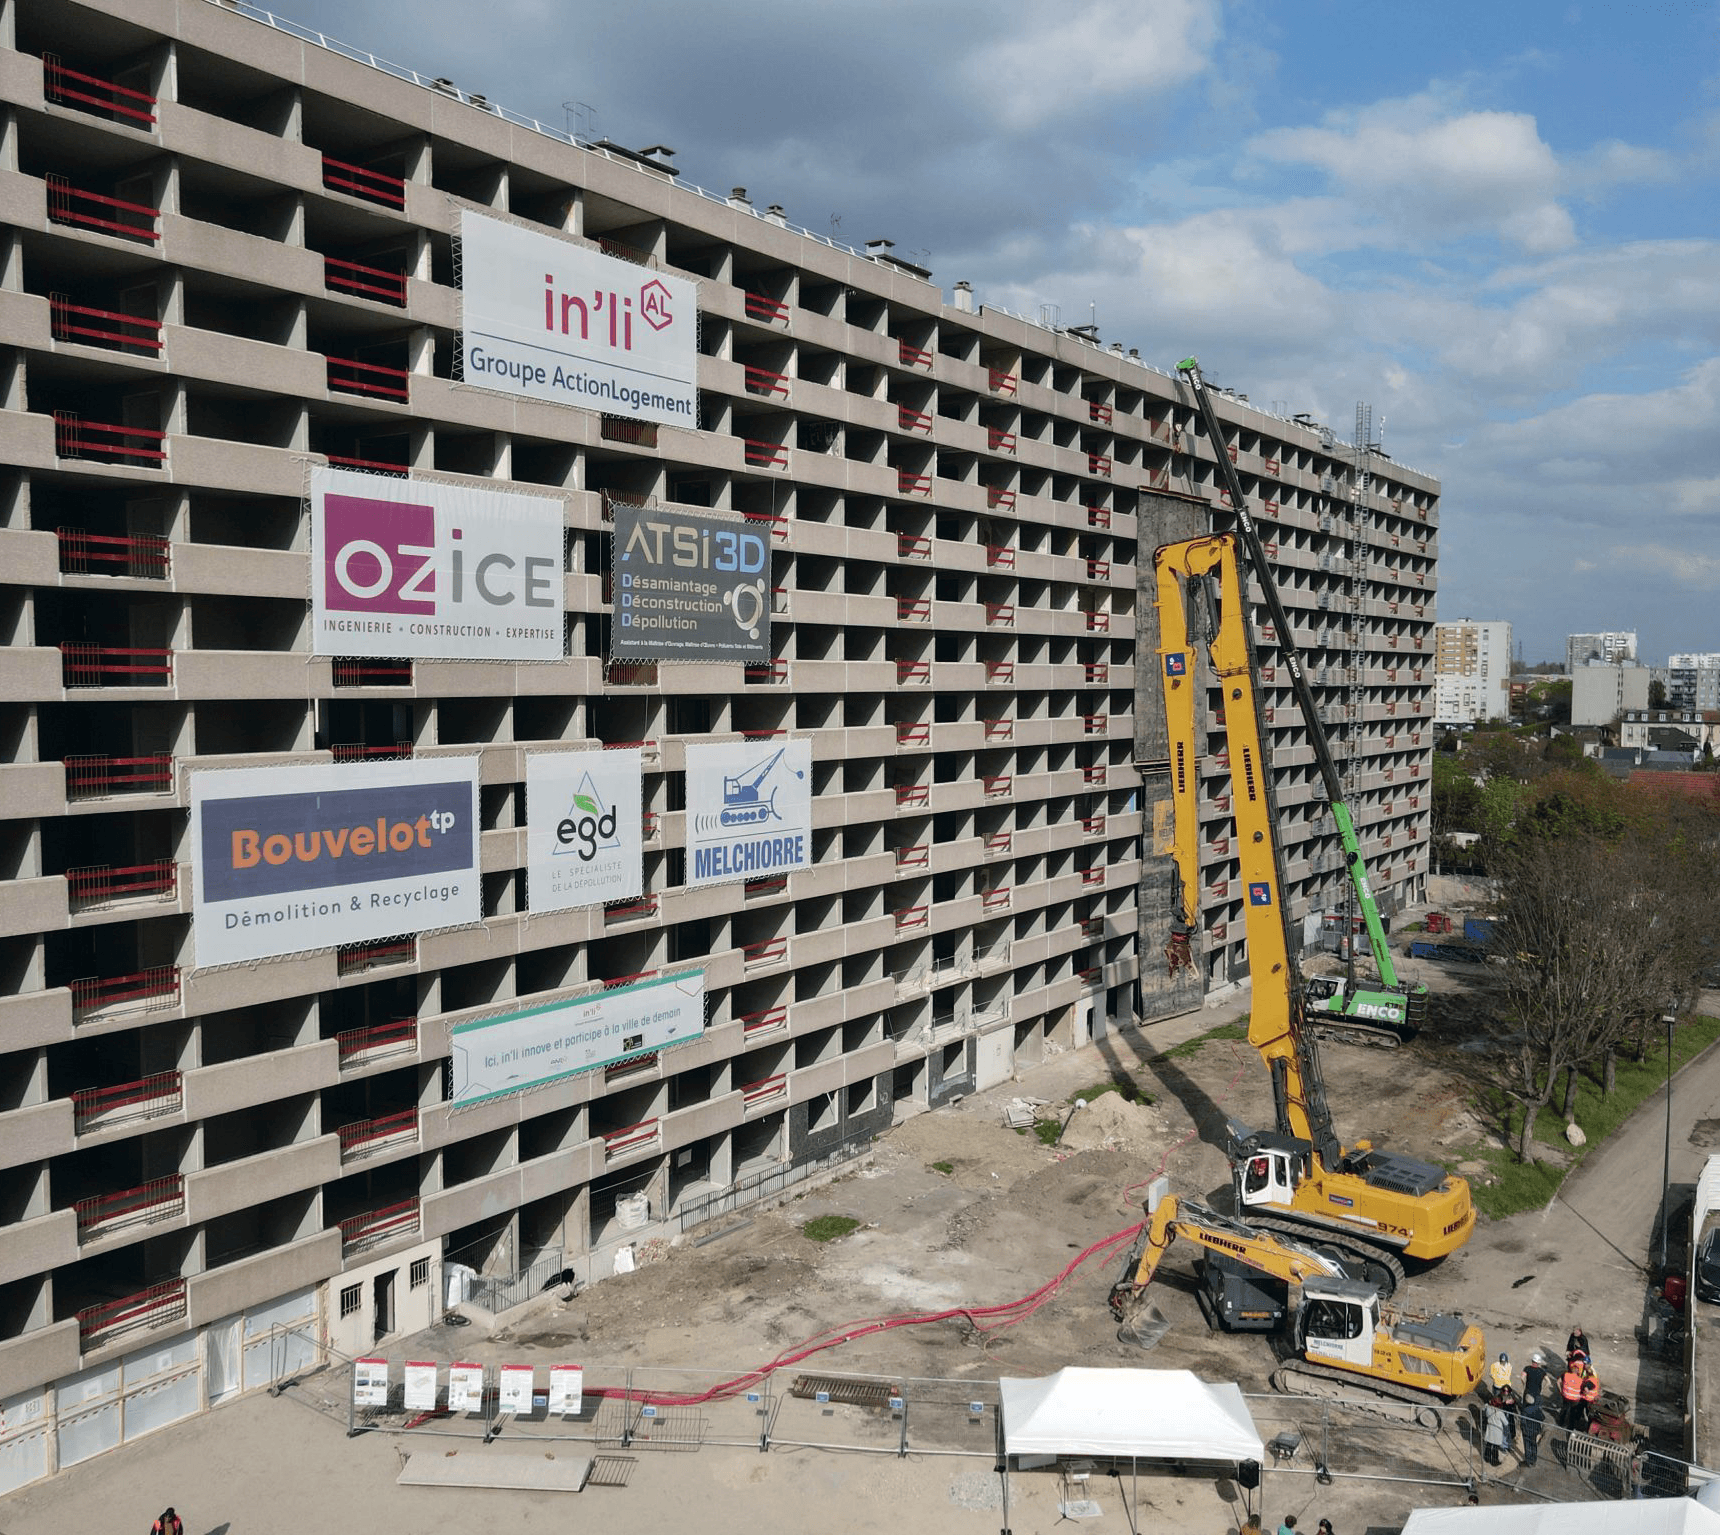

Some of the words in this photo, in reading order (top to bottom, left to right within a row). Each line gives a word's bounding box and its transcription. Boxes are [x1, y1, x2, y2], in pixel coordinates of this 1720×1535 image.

[470, 347, 546, 387] Groupe
[552, 366, 692, 415] ActionLogement
[1191, 369, 1202, 390] ENCO
[1240, 511, 1251, 533] ENCO
[622, 573, 718, 596] Désamiantage
[621, 593, 723, 613] Déconstruction
[323, 619, 392, 634] INGENIERIE
[409, 623, 491, 637] CONSTRUCTION
[505, 627, 555, 640] EXPERTISE
[621, 613, 697, 630] Dépollution
[1290, 656, 1301, 678] ENCO
[1177, 741, 1185, 793] LIEBHERR
[1243, 748, 1256, 801] LIEBHERR
[231, 815, 432, 870] Bouvelot
[430, 809, 456, 834] tp
[556, 804, 617, 861] egd
[695, 835, 804, 880] MELCHIORRE
[552, 870, 562, 879] LE
[552, 883, 562, 892] DE
[563, 881, 572, 891] LA
[225, 902, 342, 929] Démolition
[349, 896, 362, 911] &
[370, 885, 460, 908] Recyclage
[1357, 1003, 1400, 1019] ENCO
[521, 1042, 552, 1058] innove
[554, 1037, 563, 1049] et
[565, 1028, 602, 1049] participe
[604, 1025, 610, 1036] à
[612, 1023, 620, 1034] la
[622, 1018, 639, 1031] ville
[641, 1016, 651, 1026] de
[652, 1007, 681, 1023] demain
[1377, 1222, 1408, 1237] 974
[1199, 1232, 1247, 1254] LIEBHERR
